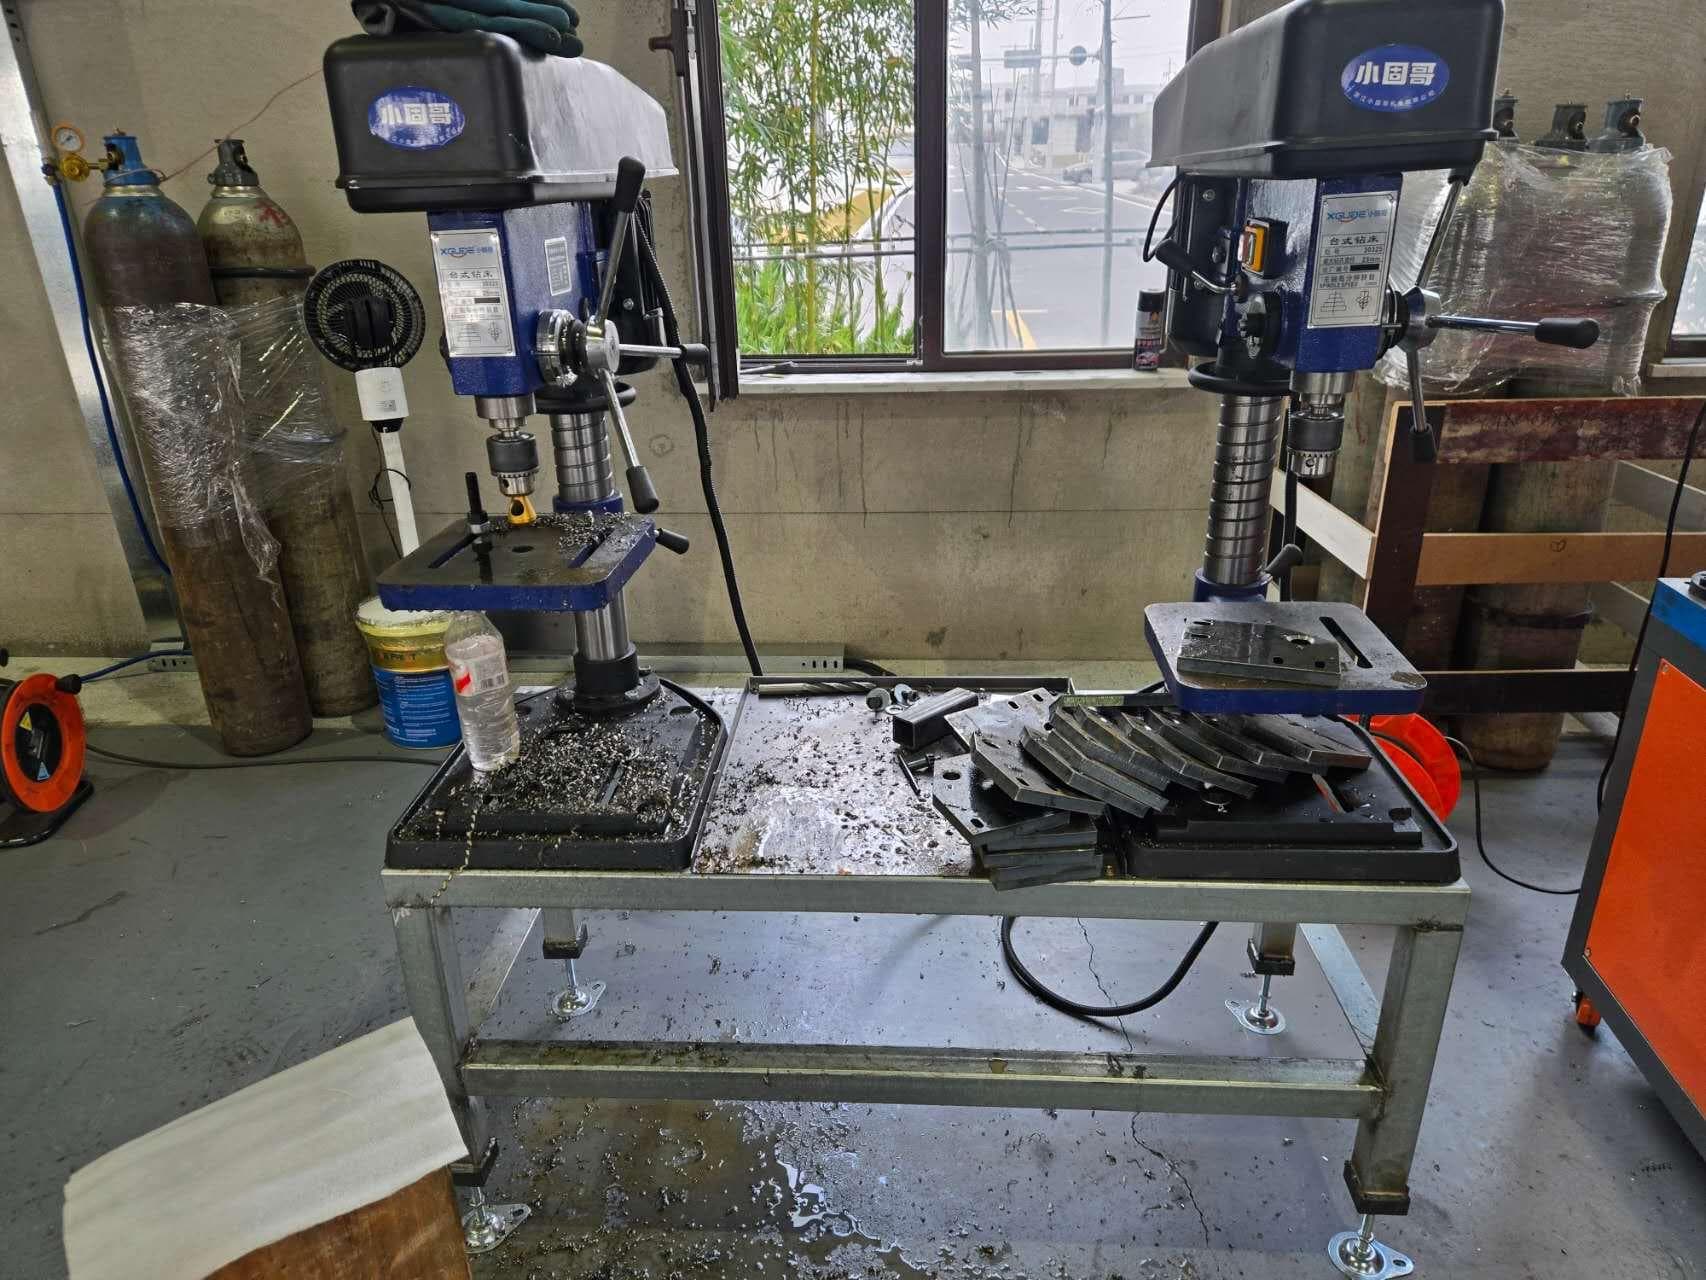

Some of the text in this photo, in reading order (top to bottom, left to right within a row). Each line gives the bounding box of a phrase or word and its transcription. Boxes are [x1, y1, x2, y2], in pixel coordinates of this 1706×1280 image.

[1355, 61, 1437, 86] 小固哥
[381, 103, 452, 125] 小固哥
